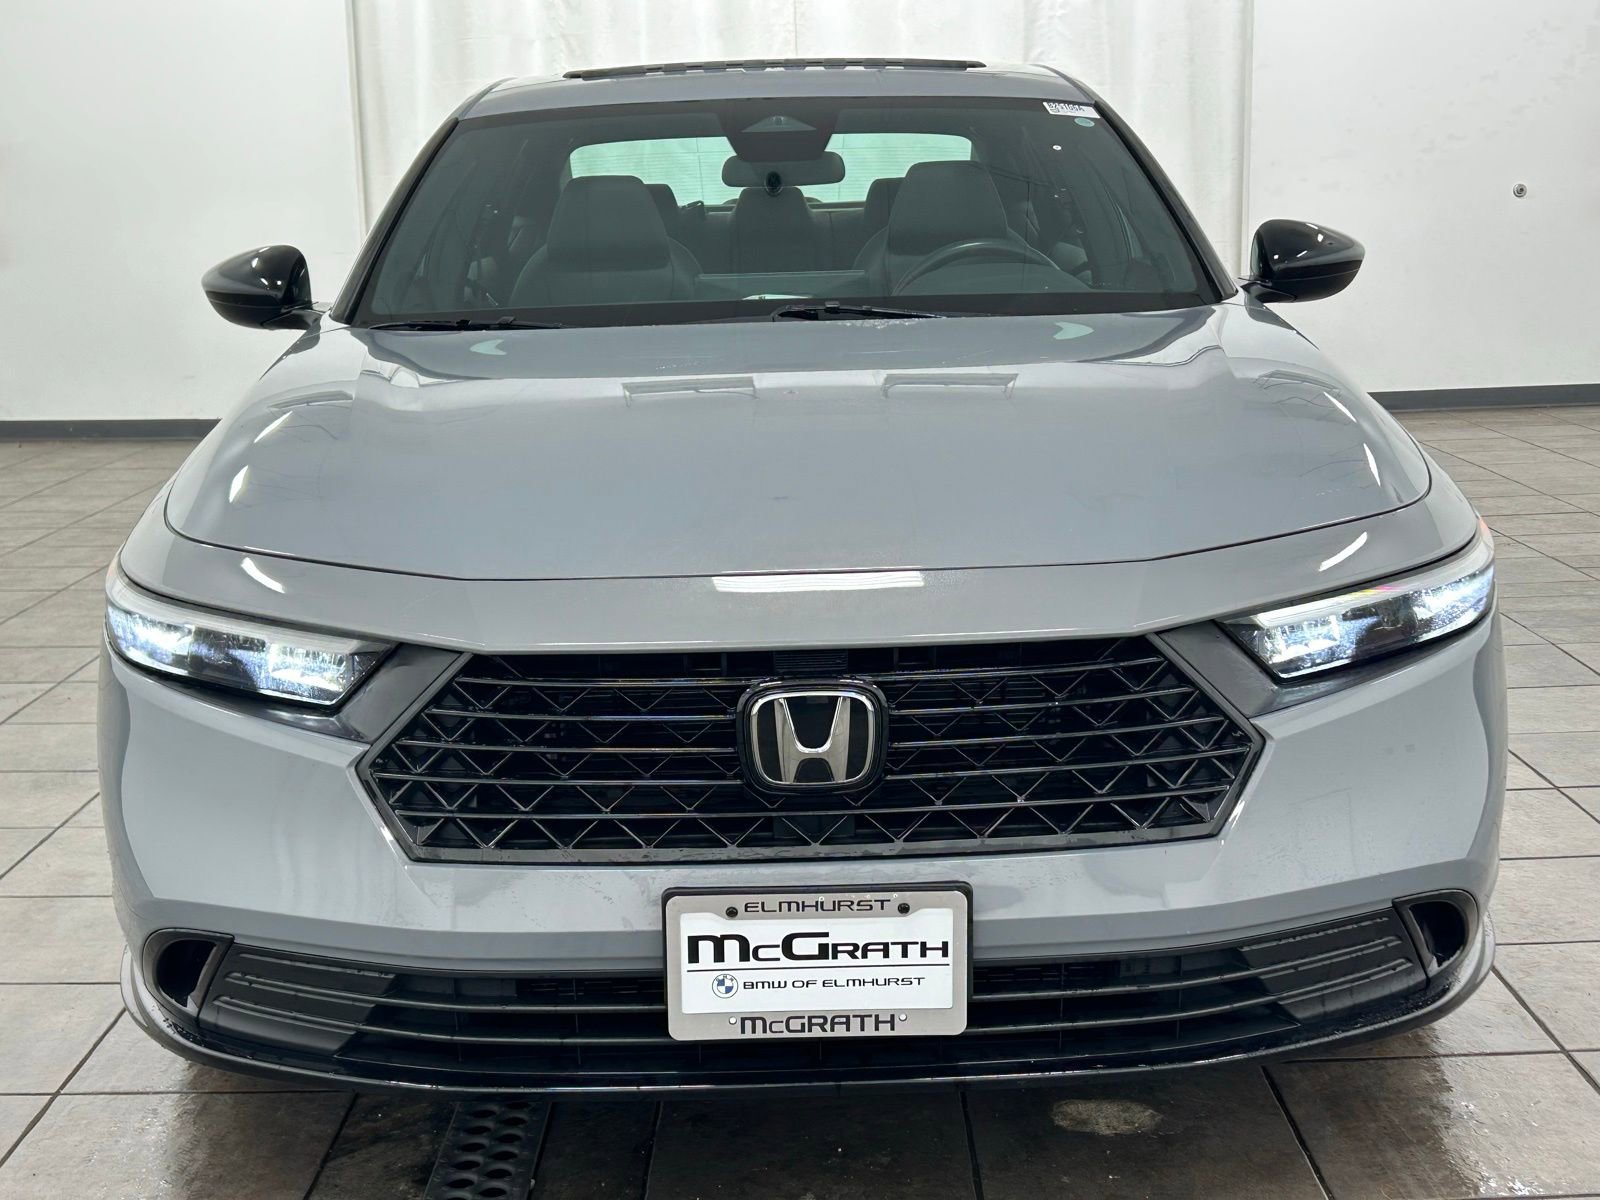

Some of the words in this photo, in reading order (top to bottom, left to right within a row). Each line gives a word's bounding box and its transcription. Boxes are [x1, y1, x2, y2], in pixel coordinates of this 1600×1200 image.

[743, 899, 891, 913] ELMHURST
[743, 980, 787, 990] BMW
[791, 979, 818, 989] OF
[822, 976, 926, 988] ELMHURST
[740, 1013, 896, 1035] McGRATH
